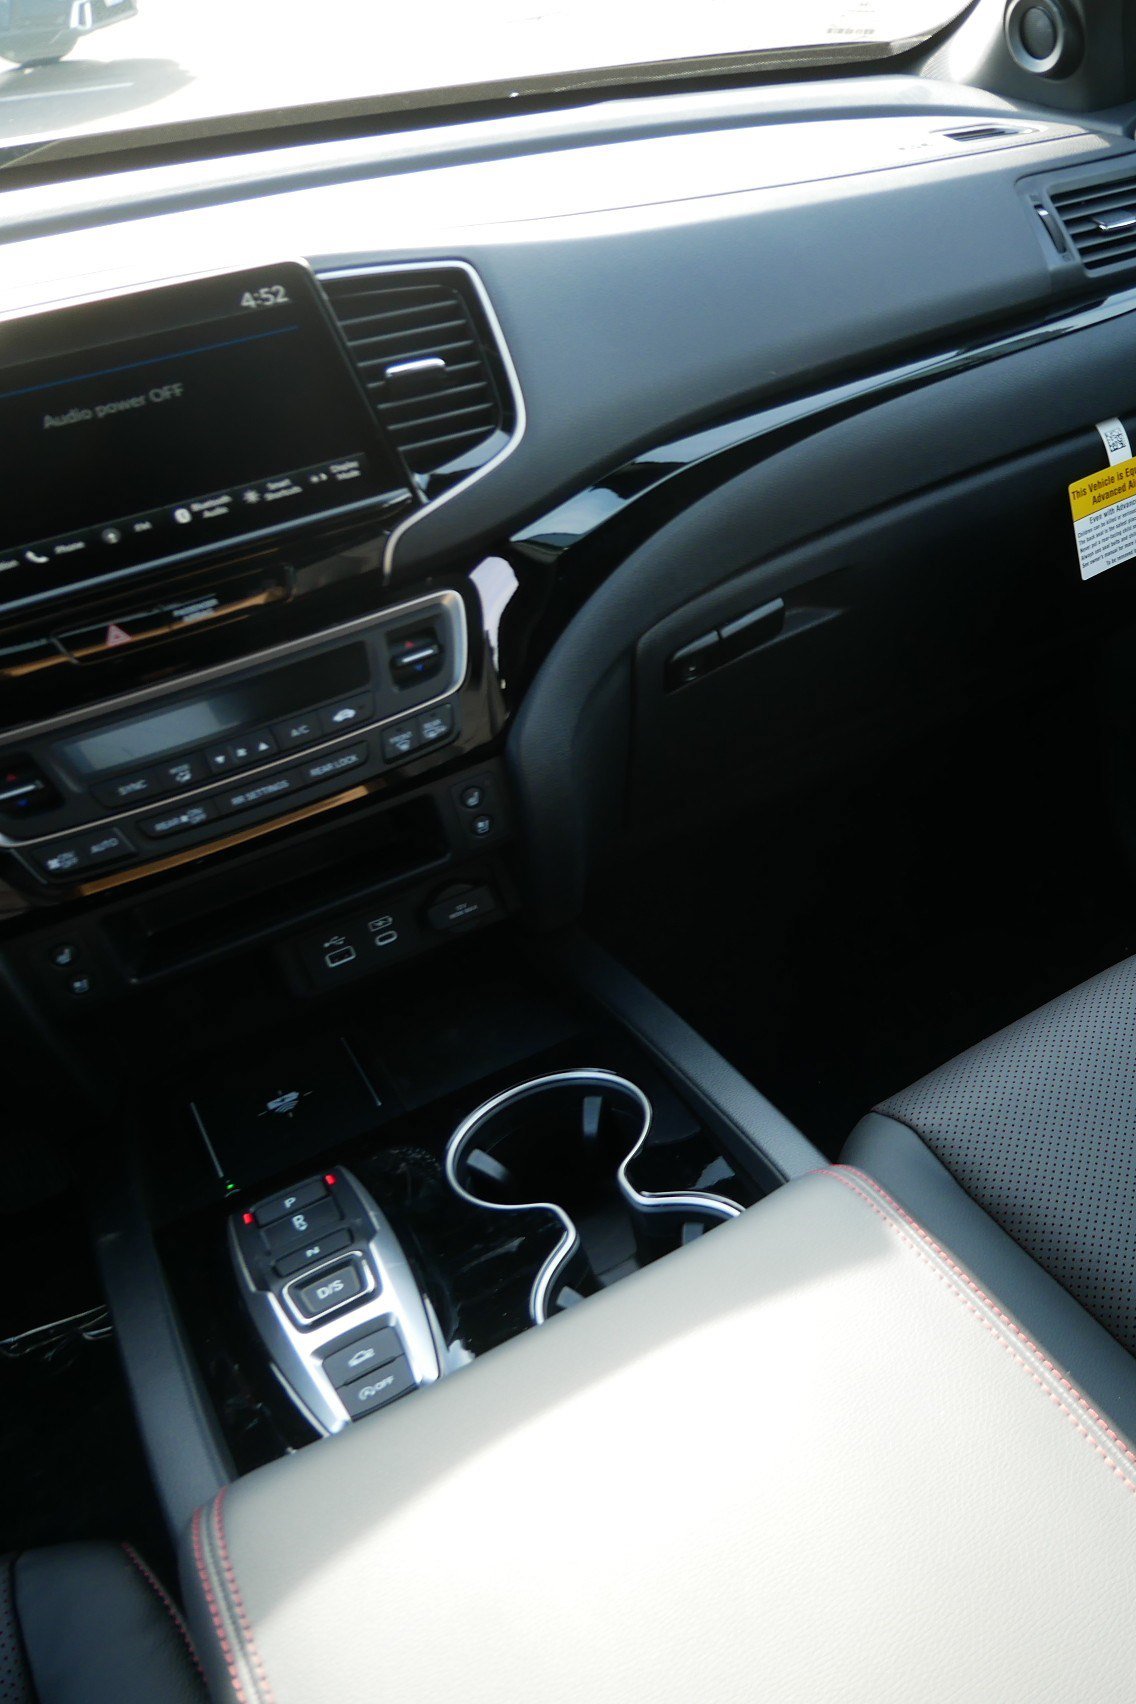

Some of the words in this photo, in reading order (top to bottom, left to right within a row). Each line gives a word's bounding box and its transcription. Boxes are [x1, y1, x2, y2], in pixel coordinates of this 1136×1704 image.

[240, 285, 290, 309] 4:52
[42, 408, 93, 430] Audio
[94, 394, 147, 418] power
[148, 381, 185, 403] OFF
[1071, 487, 1088, 500] This
[1087, 475, 1115, 493] Vehicle
[1116, 472, 1124, 481] is
[1092, 482, 1127, 505] Advanced
[1089, 514, 1103, 525] Even
[1103, 507, 1116, 518] with
[289, 724, 311, 738] A/C
[309, 763, 334, 778] REAR
[333, 754, 360, 769] LOCK
[284, 1196, 297, 1209] P
[292, 1214, 305, 1228] R
[305, 1245, 321, 1258] N
[316, 1279, 344, 1300] D/S
[374, 1375, 395, 1391] OFF
